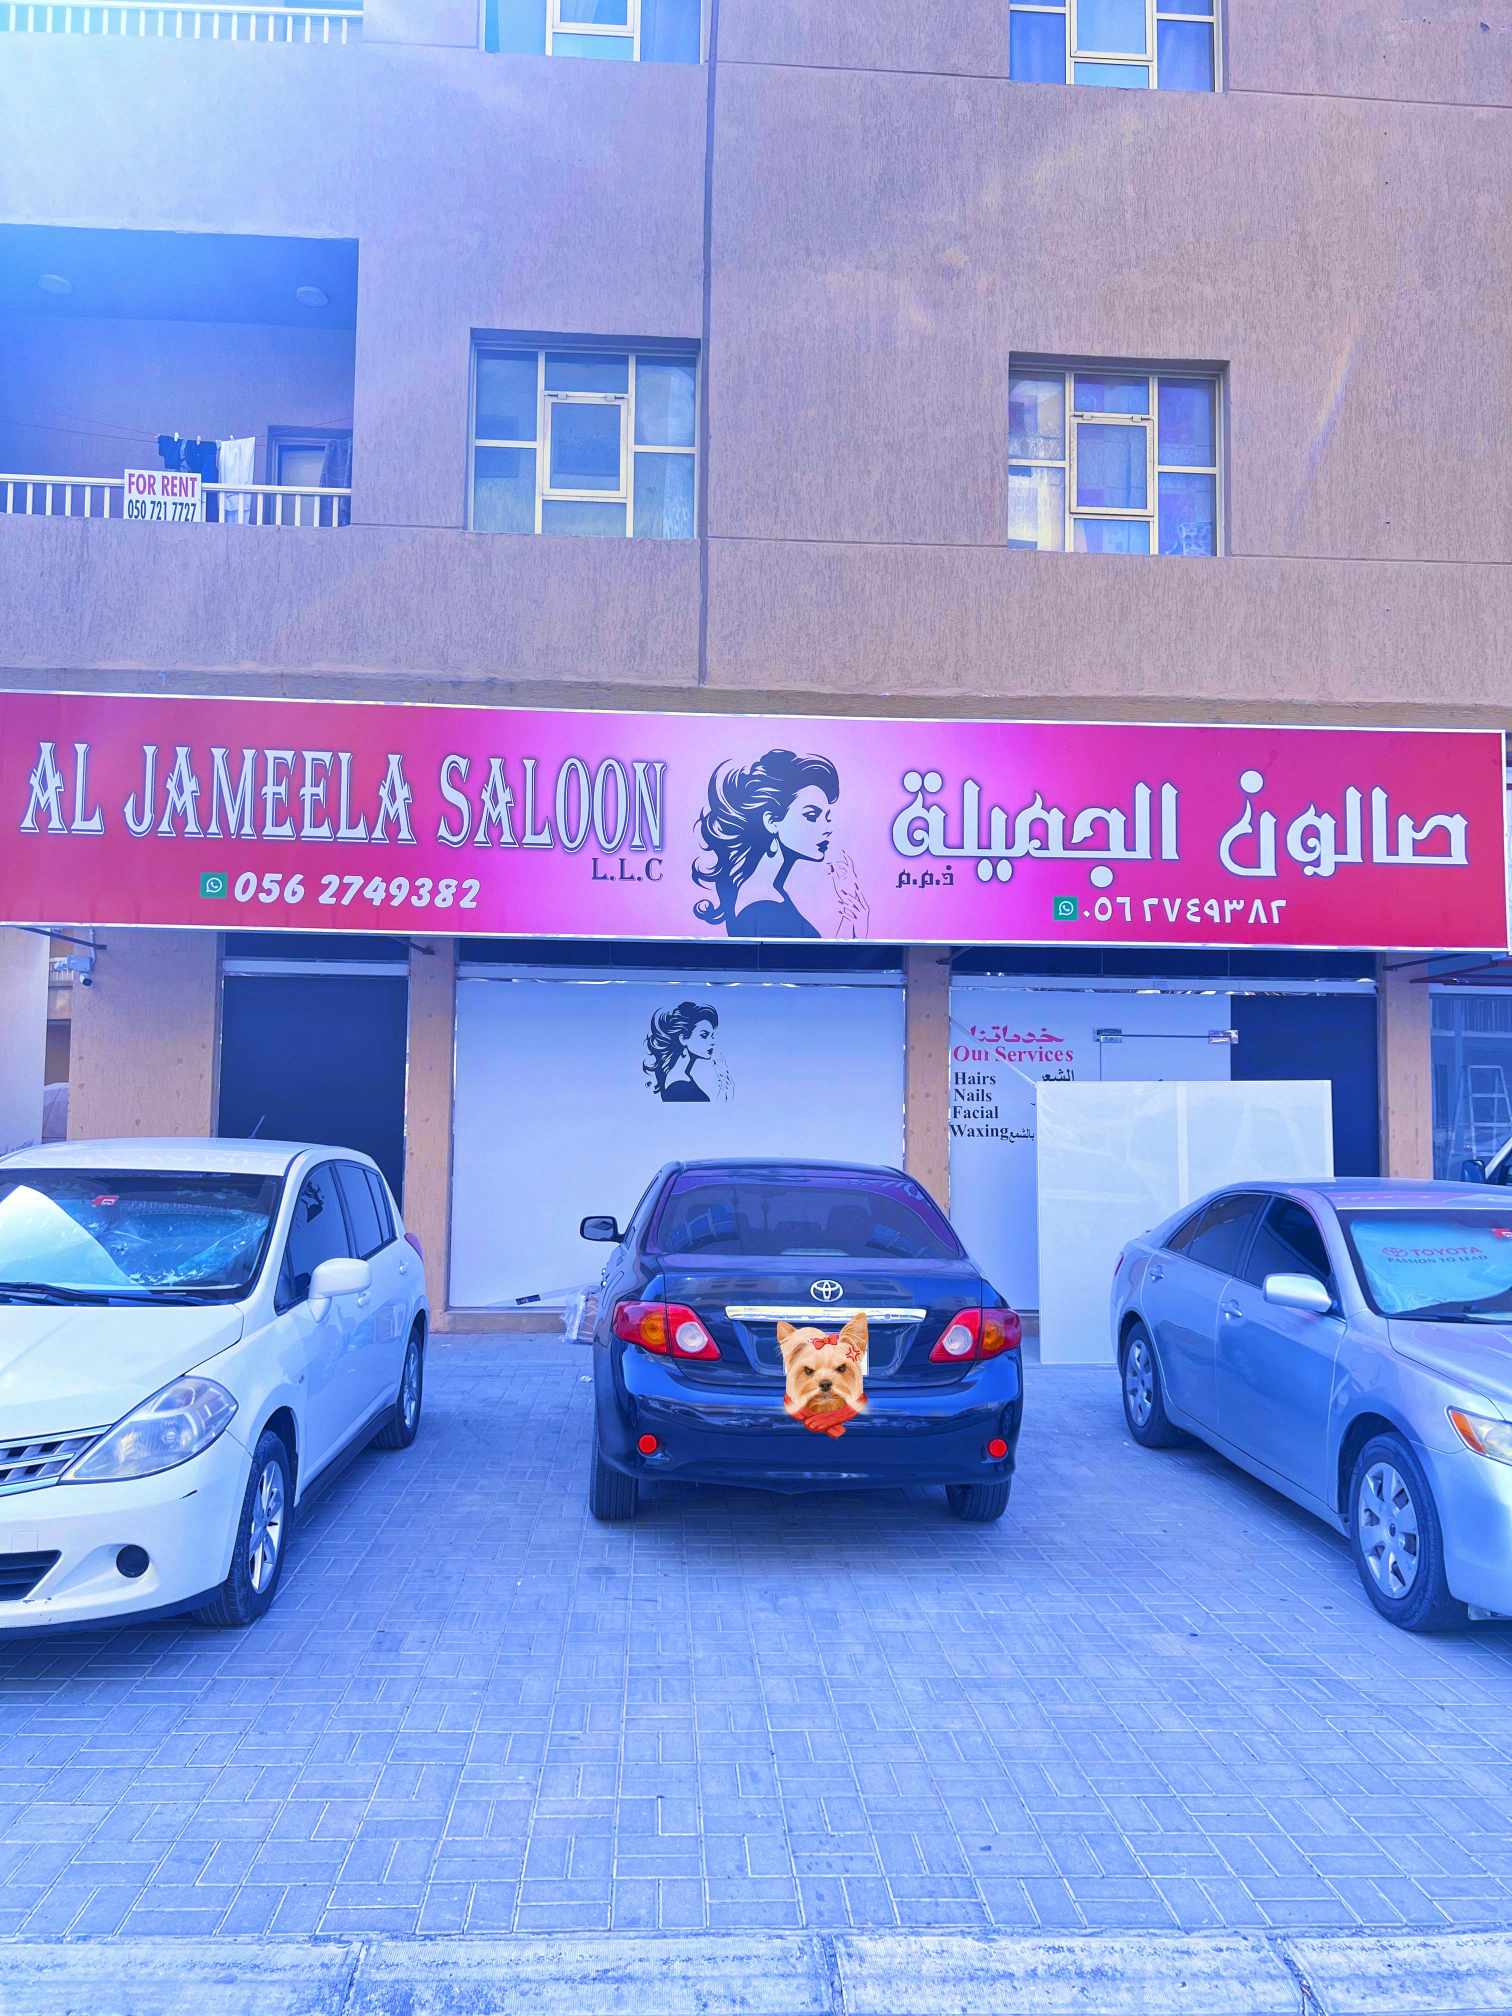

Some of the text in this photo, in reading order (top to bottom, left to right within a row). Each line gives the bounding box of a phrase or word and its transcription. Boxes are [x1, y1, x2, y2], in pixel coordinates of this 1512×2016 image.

[127, 473, 198, 498] FOR RENT
[127, 499, 197, 522] 050 721 7727
[19, 741, 668, 855] AL JAMEELA SALOON
[890, 769, 1470, 888] صالون الجميلة
[590, 857, 664, 883] L.L.C
[233, 871, 481, 911] 056 2749382
[1142, 896, 1288, 924] ٢٧٤٩٣٨٢
[968, 1024, 1065, 1044] خدماتنا
[994, 1045, 1074, 1062] Services
[954, 1071, 997, 1085] Hairs
[953, 1088, 993, 1102] Nails
[952, 1105, 999, 1119] Facial
[950, 1124, 1009, 1140] Waxing
[1410, 1247, 1484, 1256] TOYOTA
